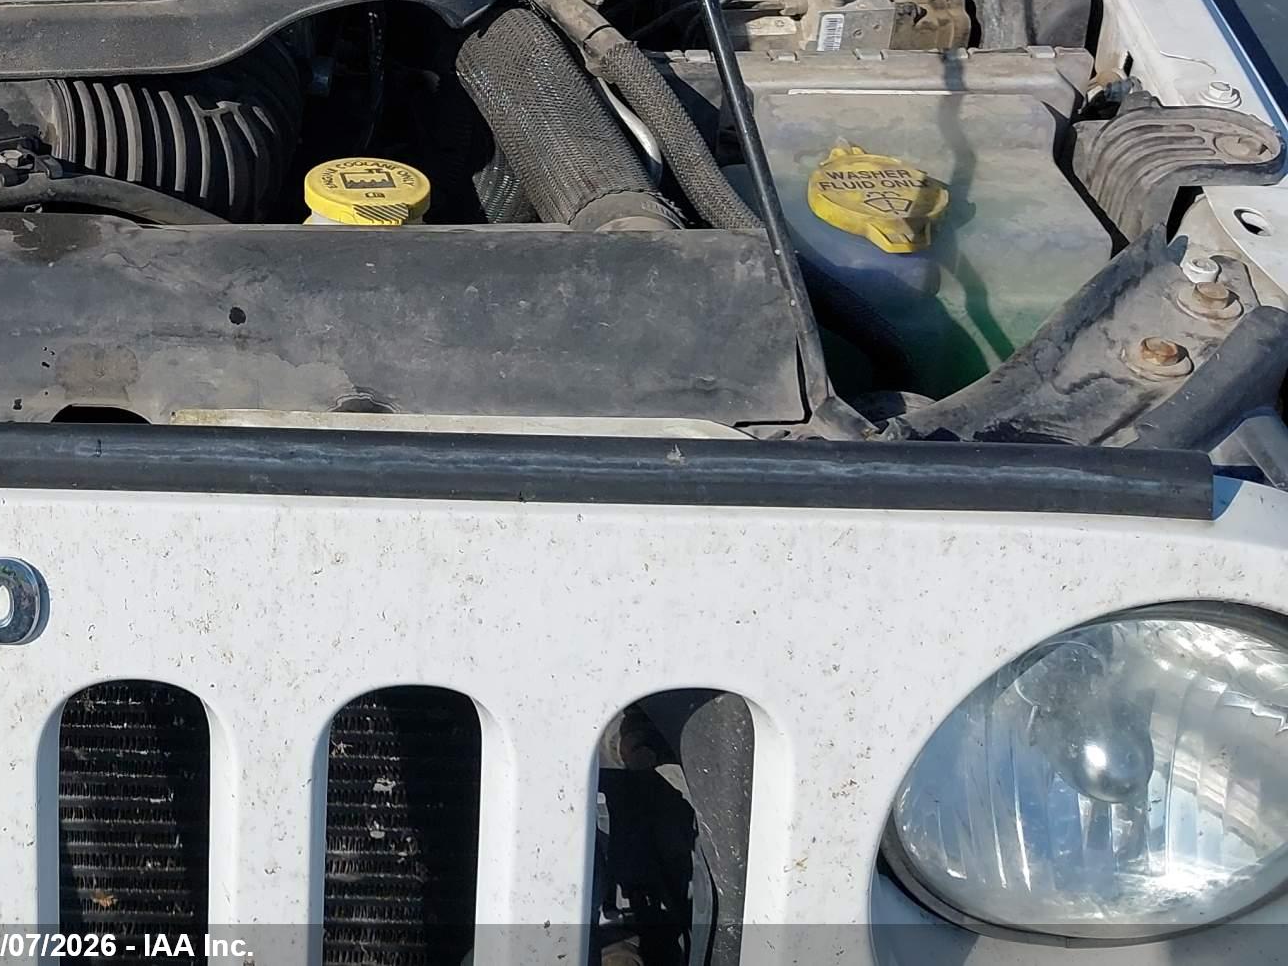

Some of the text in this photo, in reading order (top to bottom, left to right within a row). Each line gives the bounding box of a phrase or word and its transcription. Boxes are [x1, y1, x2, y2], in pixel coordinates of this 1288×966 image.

[337, 161, 396, 171] COOLANT
[826, 169, 911, 181] WASHER
[818, 179, 930, 191] FLUID ONLY
